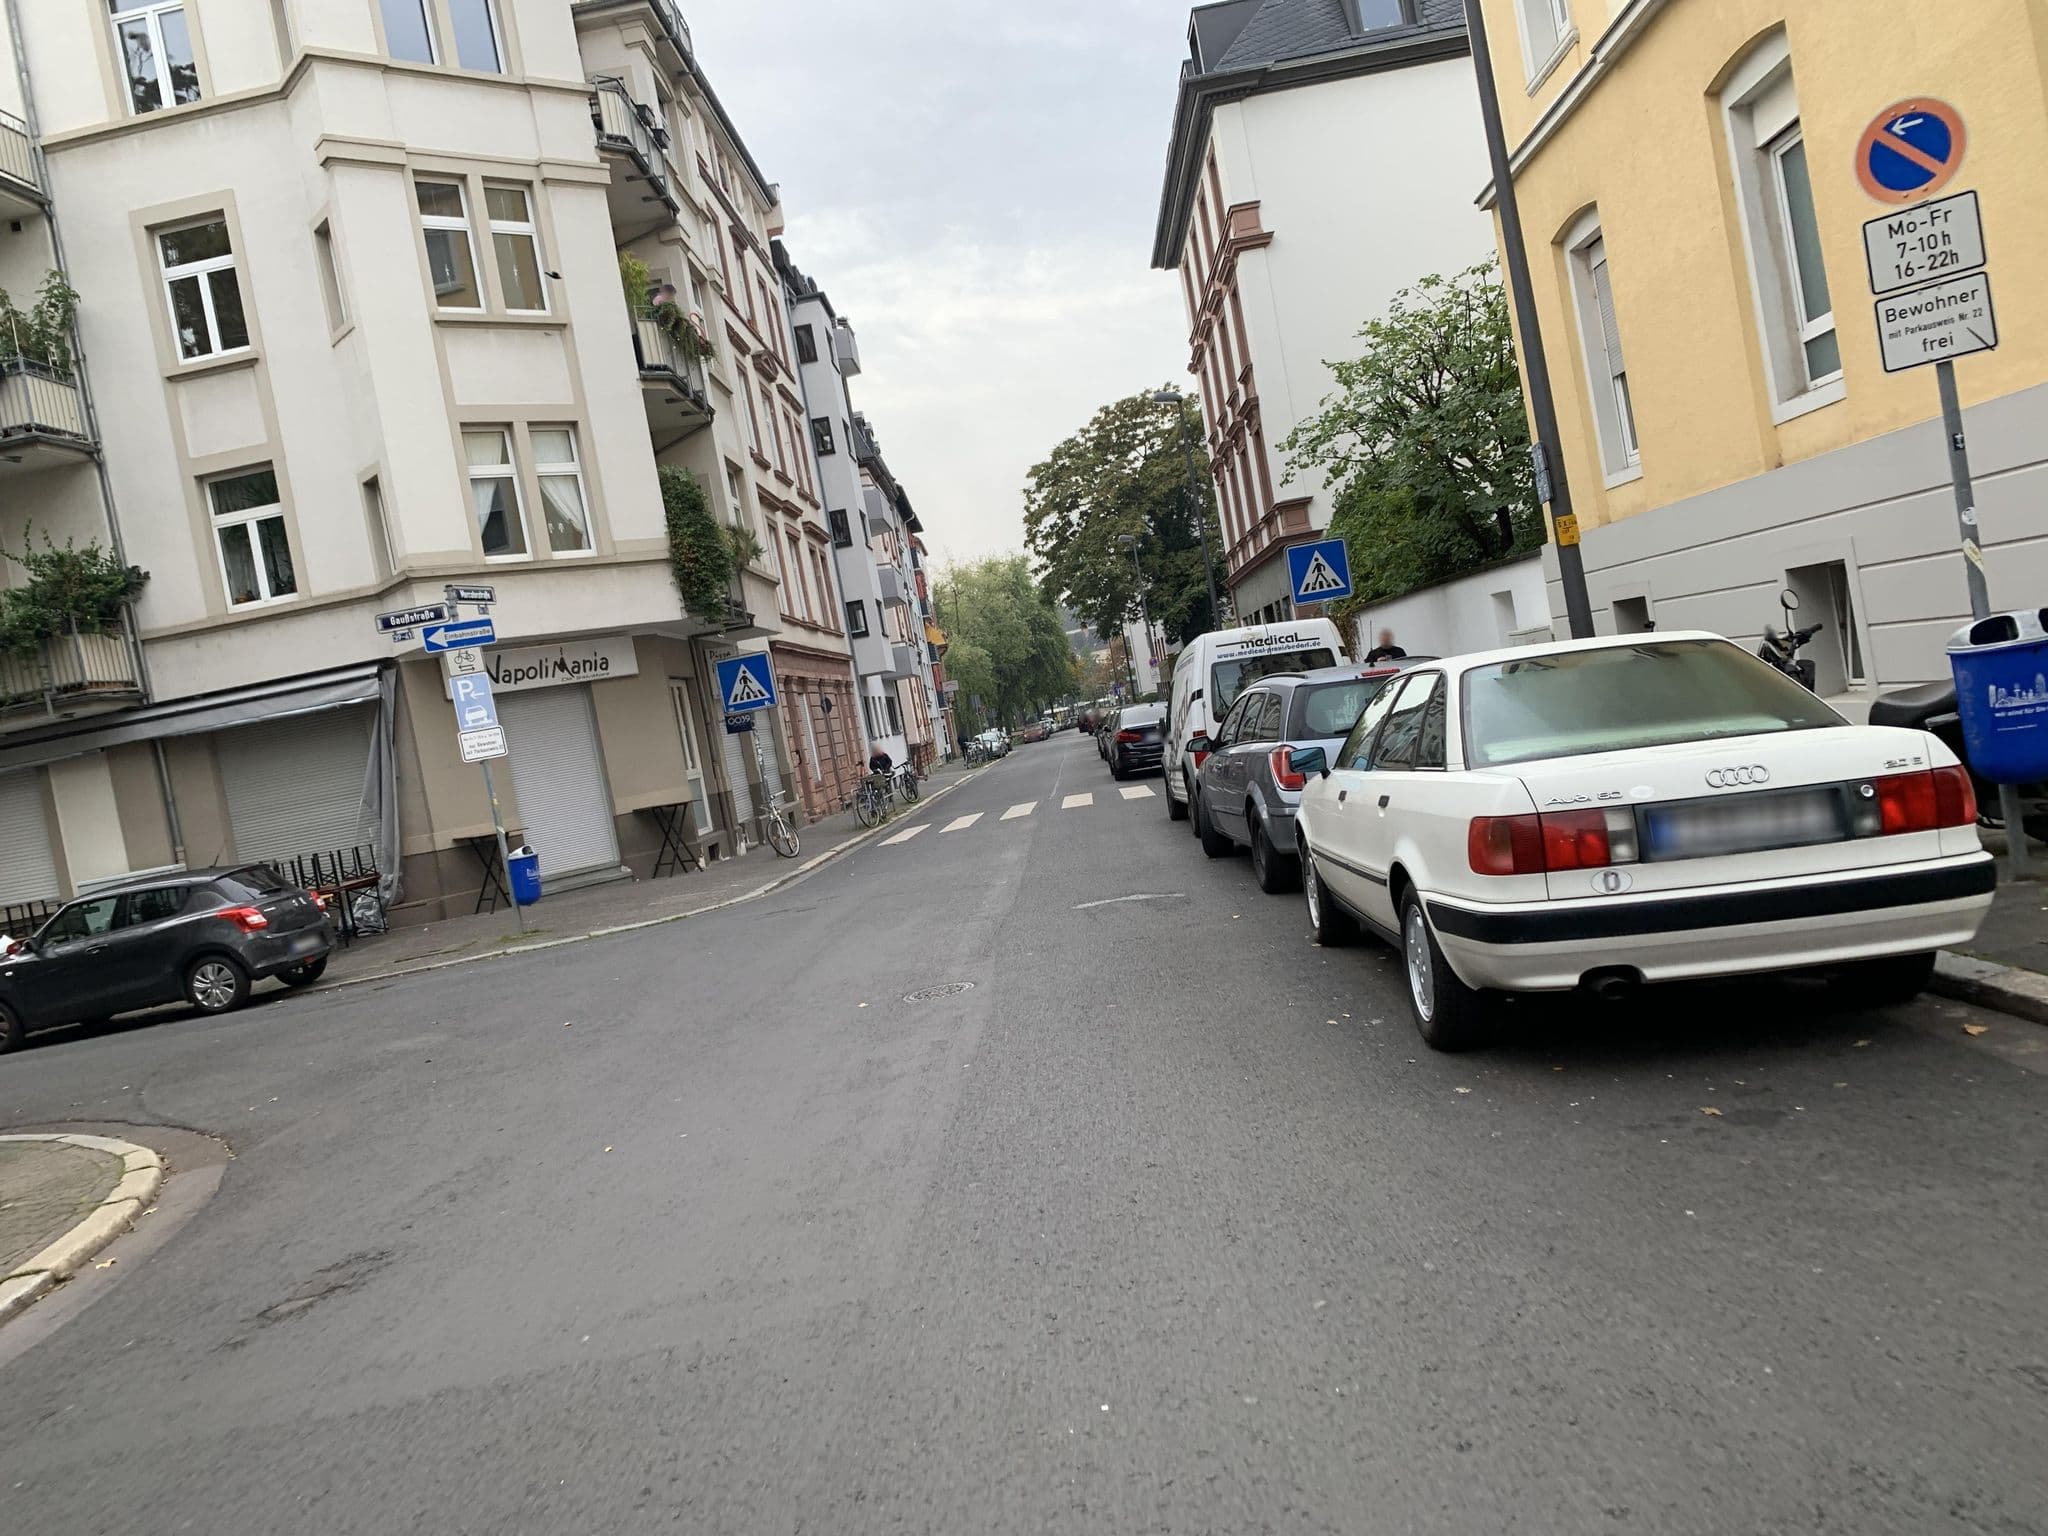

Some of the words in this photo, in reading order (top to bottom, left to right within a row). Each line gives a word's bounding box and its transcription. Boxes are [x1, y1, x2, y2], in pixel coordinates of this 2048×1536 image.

[1888, 208, 1953, 240] Mo-Fr
[1885, 288, 1979, 323] Bewohner
[1888, 328, 1902, 340] mit
[1905, 317, 1955, 335] Parkausweis
[1972, 307, 1984, 319] 22
[1921, 331, 1954, 353] frei
[389, 609, 436, 626] Gaußstraße
[443, 627, 491, 641] Einbahnstraße
[1240, 632, 1300, 649] medical
[456, 679, 474, 702] P
[1544, 793, 1592, 806] Audi
